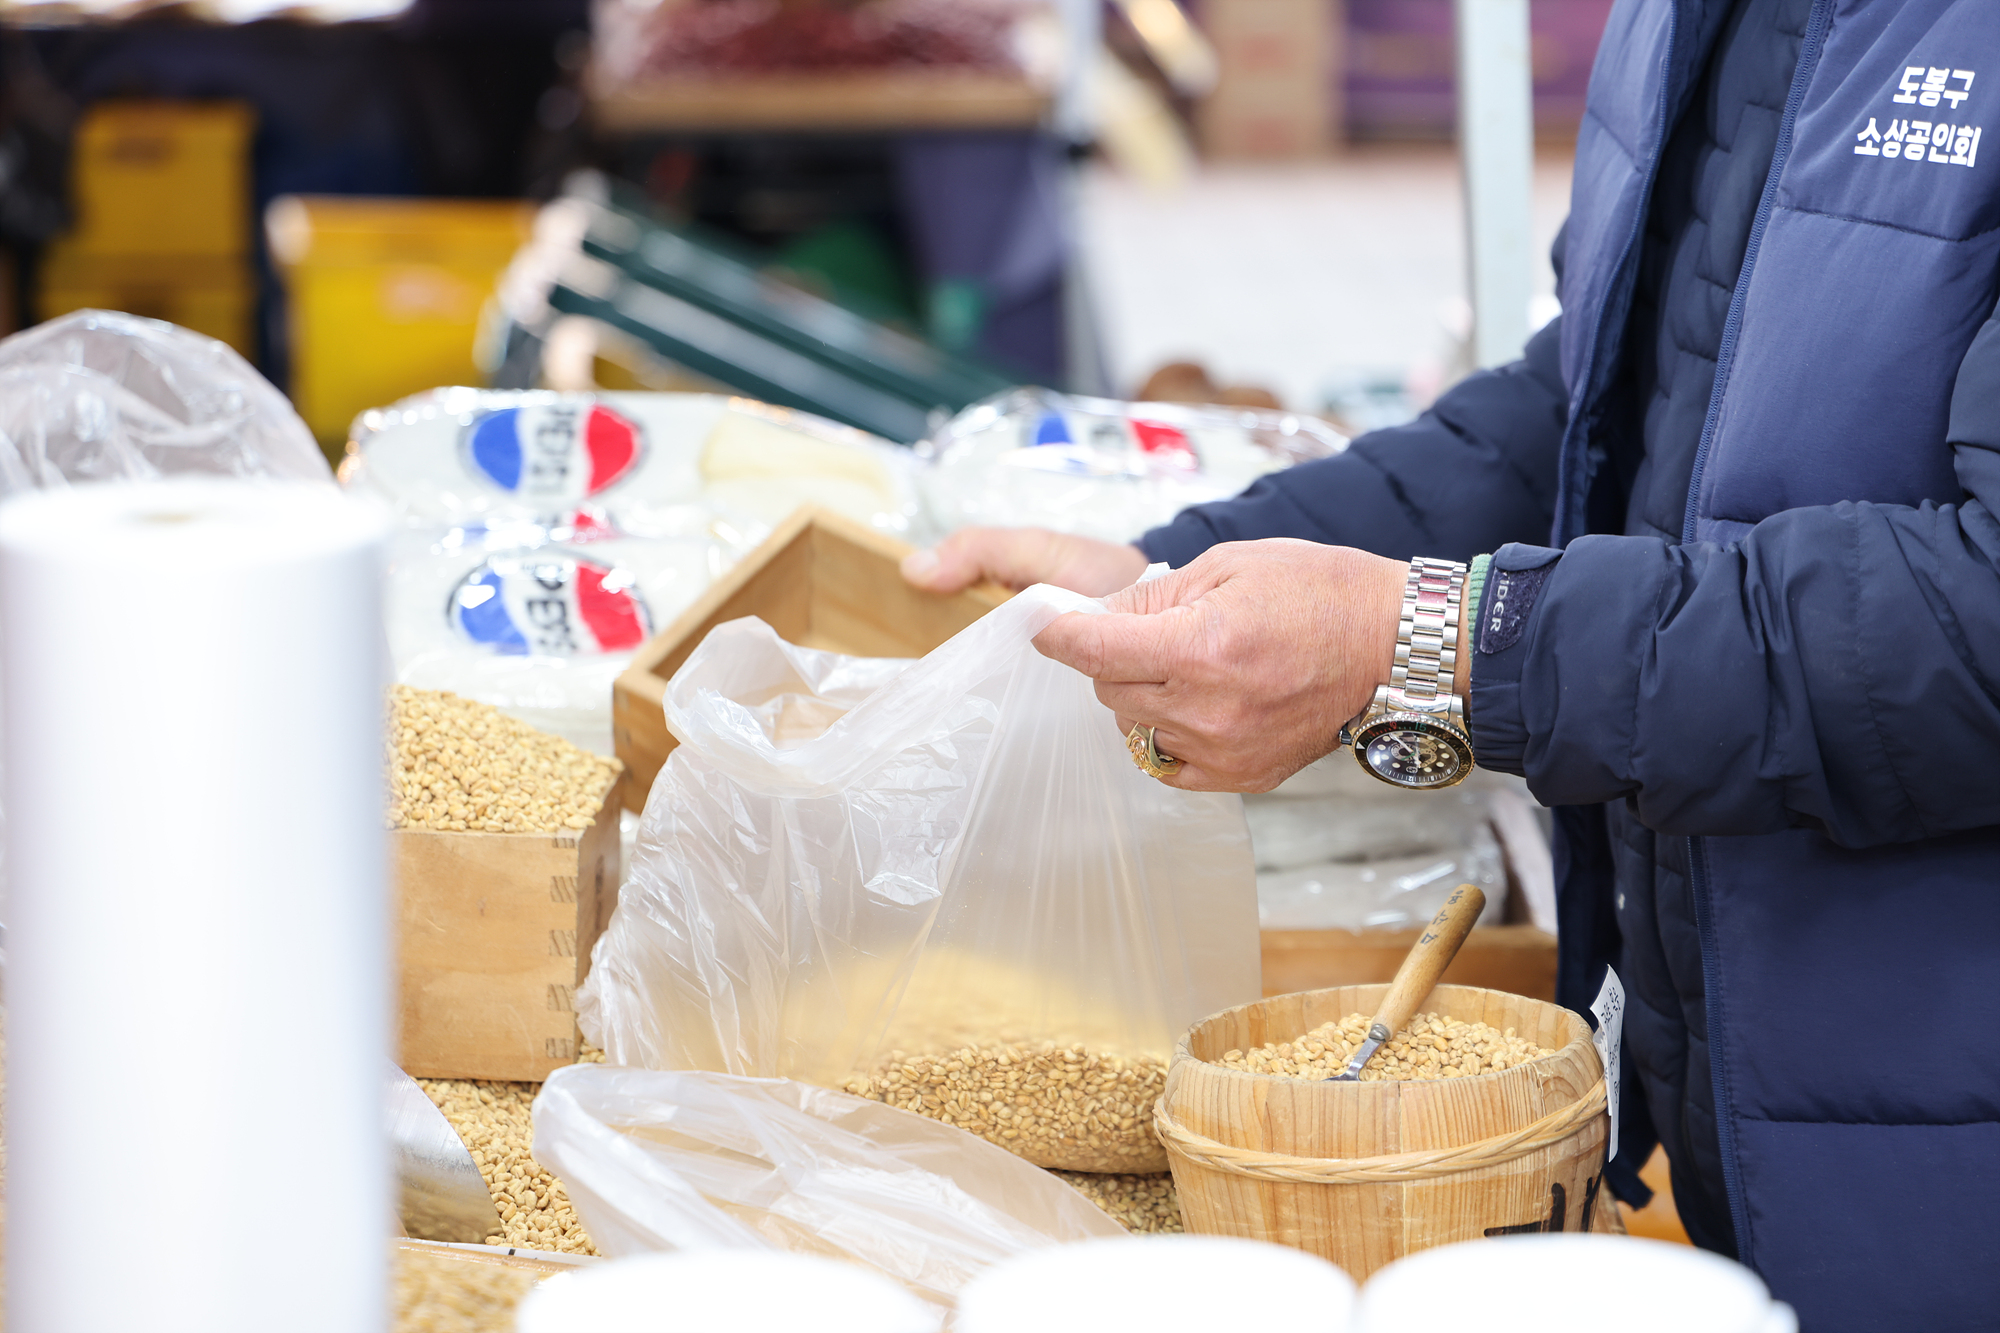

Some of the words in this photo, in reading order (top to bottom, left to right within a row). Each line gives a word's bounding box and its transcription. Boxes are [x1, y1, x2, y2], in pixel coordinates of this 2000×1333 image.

[1892, 66, 1975, 109] 도봉구
[1854, 117, 1982, 168] 소상공인회
[1415, 722, 1427, 732] 15
